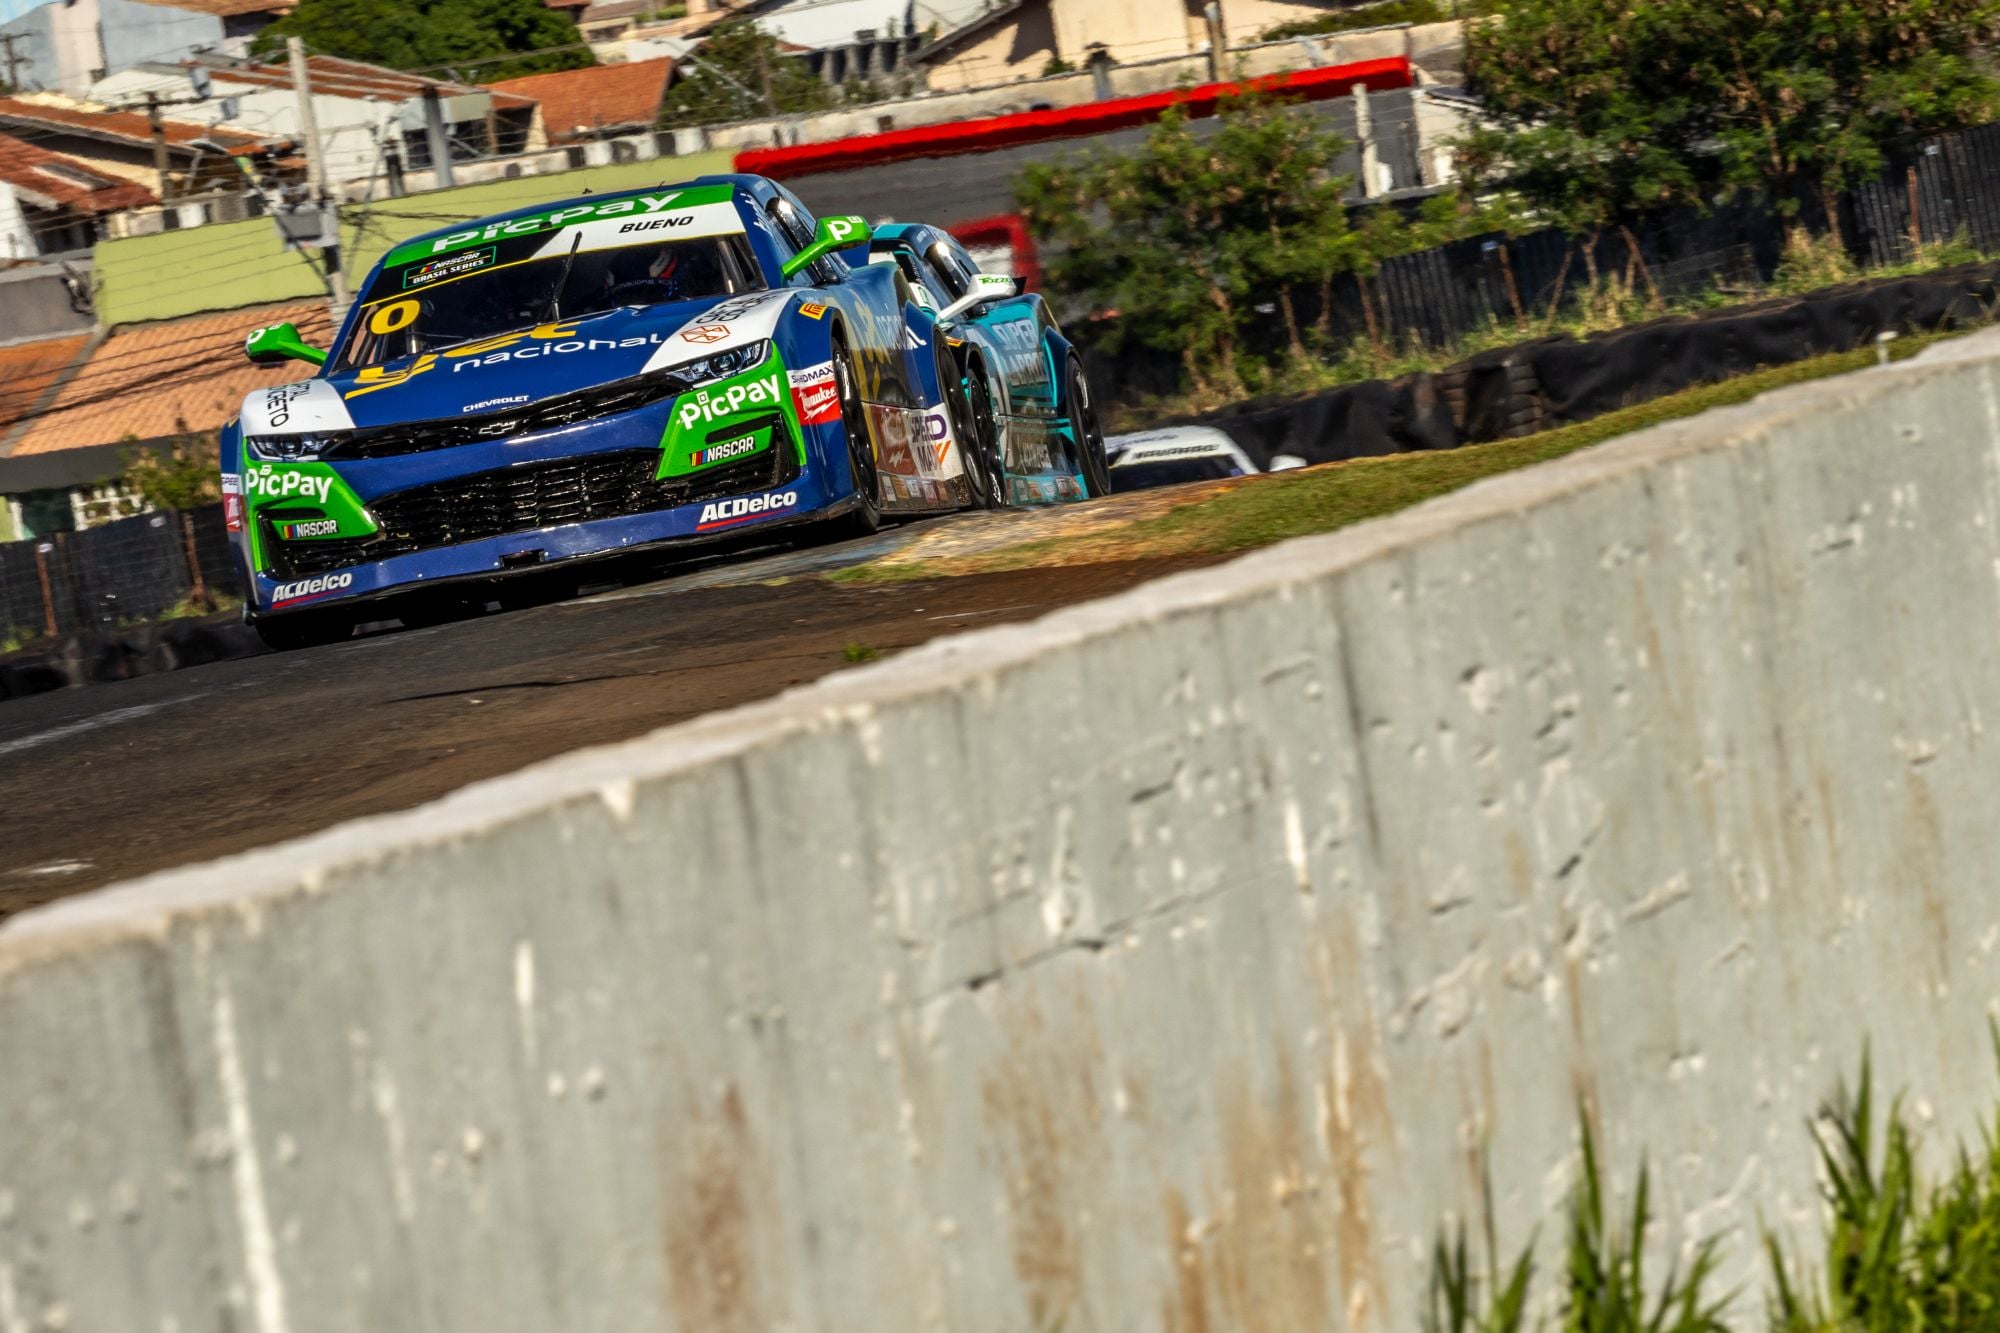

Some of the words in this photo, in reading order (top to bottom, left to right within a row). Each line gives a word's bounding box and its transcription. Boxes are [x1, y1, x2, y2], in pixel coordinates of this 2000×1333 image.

[432, 192, 684, 252] PicPay
[618, 216, 694, 234] BUENO
[412, 270, 449, 284] BRASIL
[450, 259, 485, 273] SERIES
[434, 252, 480, 269] NASCAR
[370, 299, 421, 335] 0
[453, 333, 663, 373] nacional
[463, 395, 530, 412] CHEVROLET
[679, 374, 782, 430] PicPay
[707, 436, 755, 462] NASCAR
[245, 465, 334, 504] PicPay
[700, 491, 798, 524] ACDelco
[297, 520, 338, 538] NASCAR
[272, 573, 353, 602] ACDelco
